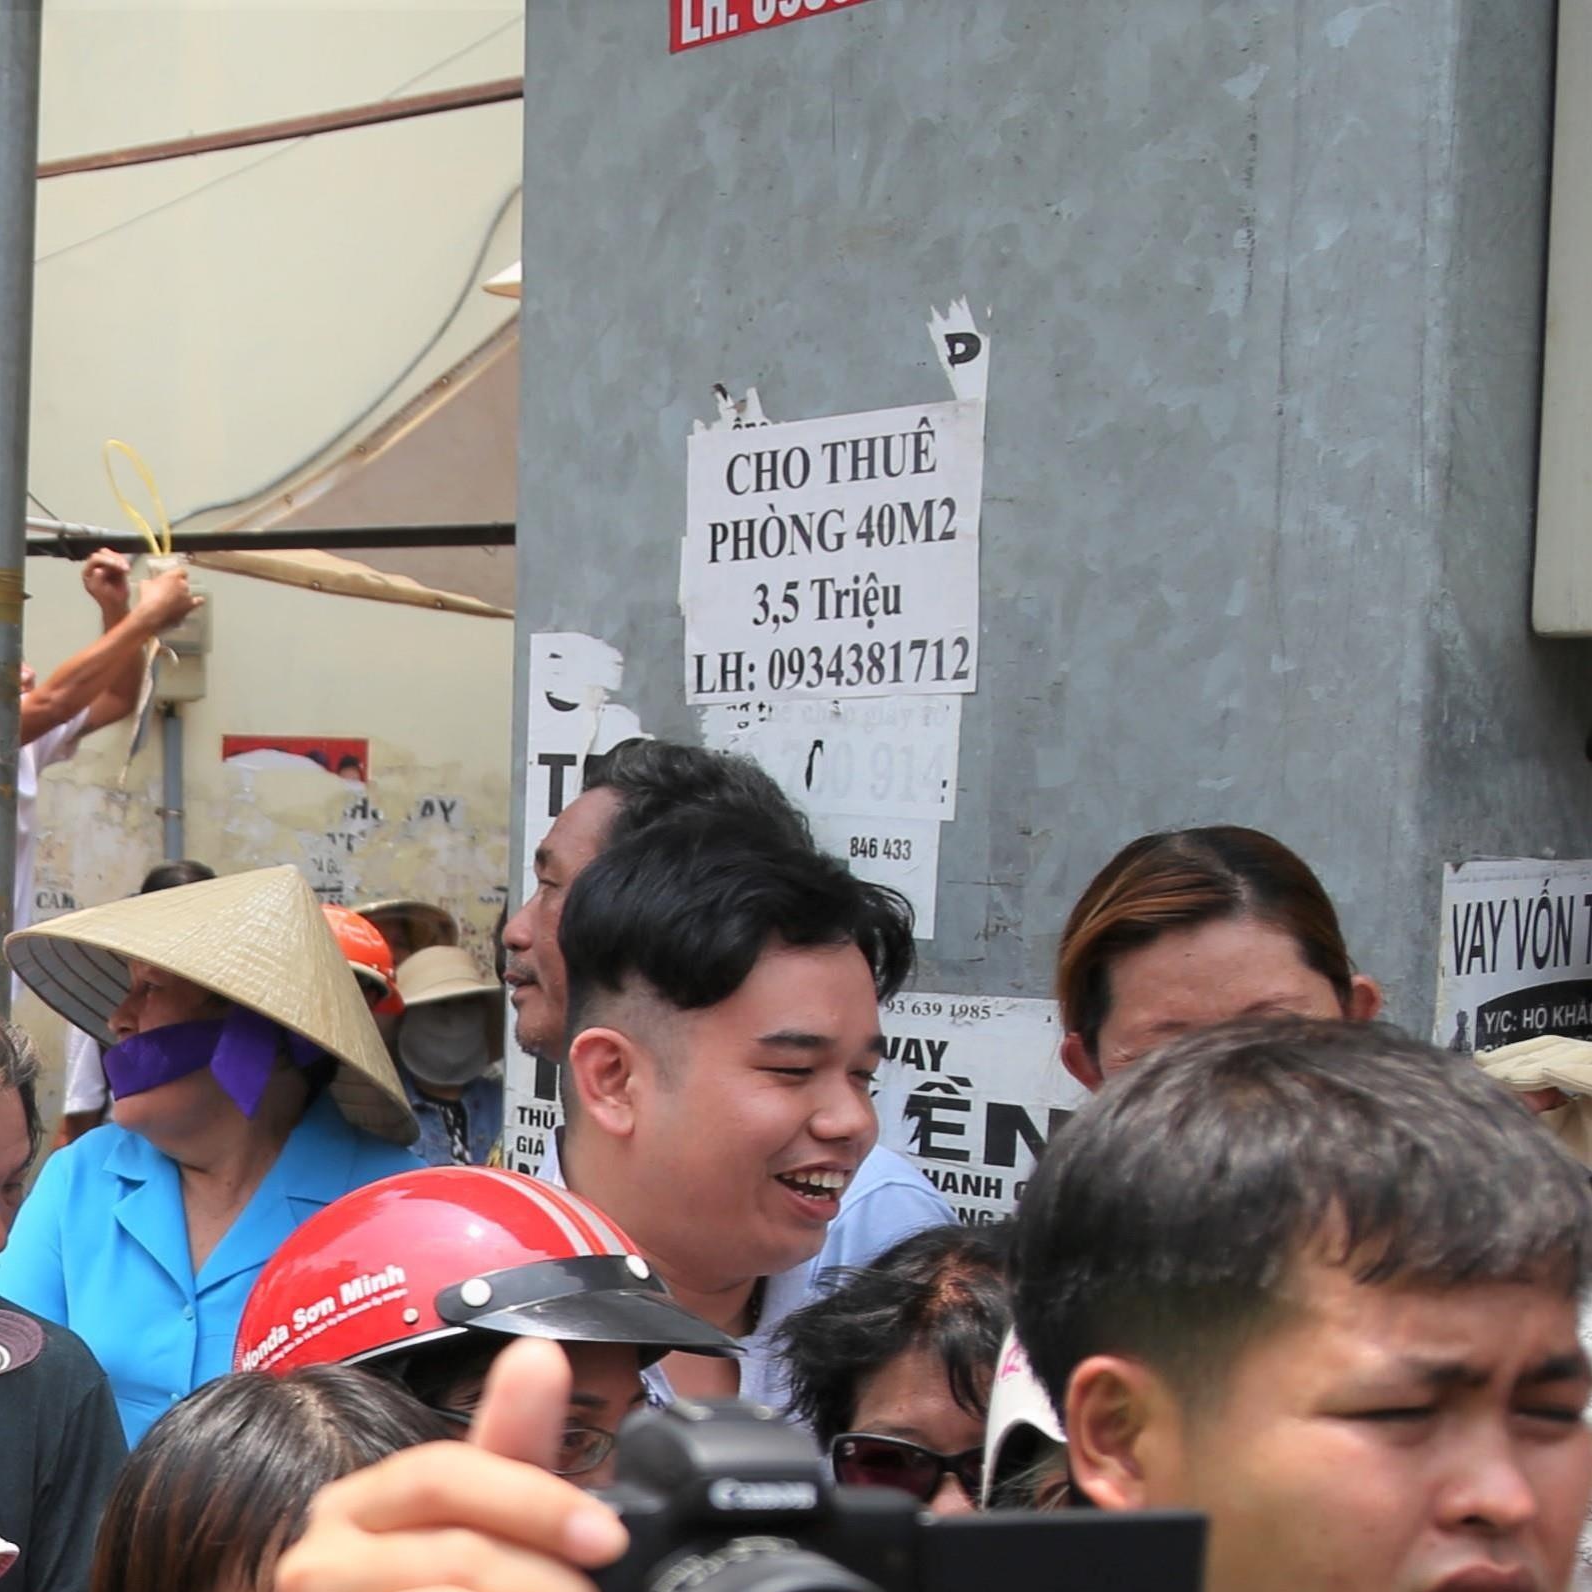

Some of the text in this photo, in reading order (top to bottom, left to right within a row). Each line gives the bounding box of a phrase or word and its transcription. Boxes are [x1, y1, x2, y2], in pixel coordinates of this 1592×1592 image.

[725, 416, 937, 496] CHO THUÊ
[708, 496, 957, 564] PHÒNG 40M2
[752, 571, 903, 634] 3,5 Triệu
[693, 636, 972, 695] LH: 0934381712
[849, 836, 912, 861] 846 433
[1452, 899, 1508, 977] VAY
[1513, 878, 1576, 971] VỐN
[911, 1001, 943, 1016] 639
[1483, 1009, 1518, 1035] Y/C:
[517, 1104, 556, 1130] THỦ
[241, 1324, 290, 1374] Honda
[292, 1295, 337, 1332] Sơn
[338, 1263, 407, 1306] Minh
